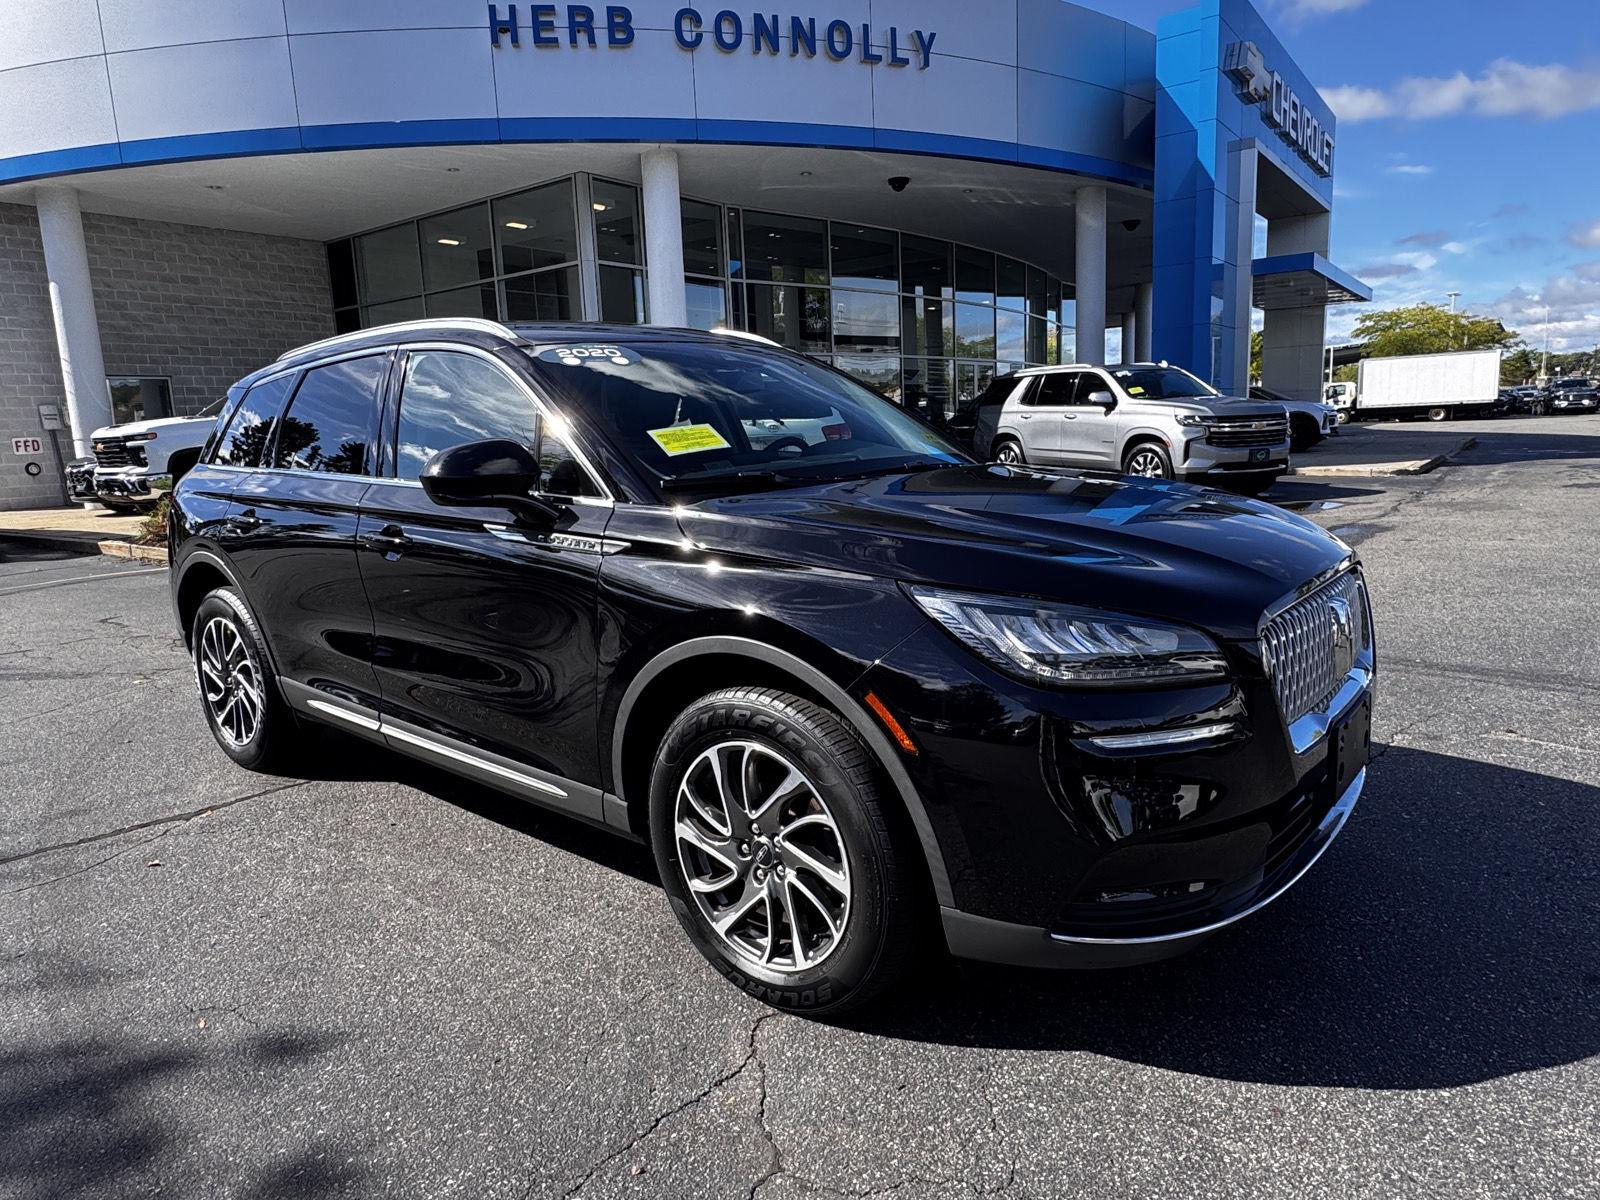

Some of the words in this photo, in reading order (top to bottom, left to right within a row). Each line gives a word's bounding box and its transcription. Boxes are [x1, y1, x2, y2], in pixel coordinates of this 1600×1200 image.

[487, 4, 634, 48] HERB
[674, 7, 936, 70] CONNOLLY
[1268, 70, 1335, 178] CHEVROLET
[555, 348, 622, 358] 2020
